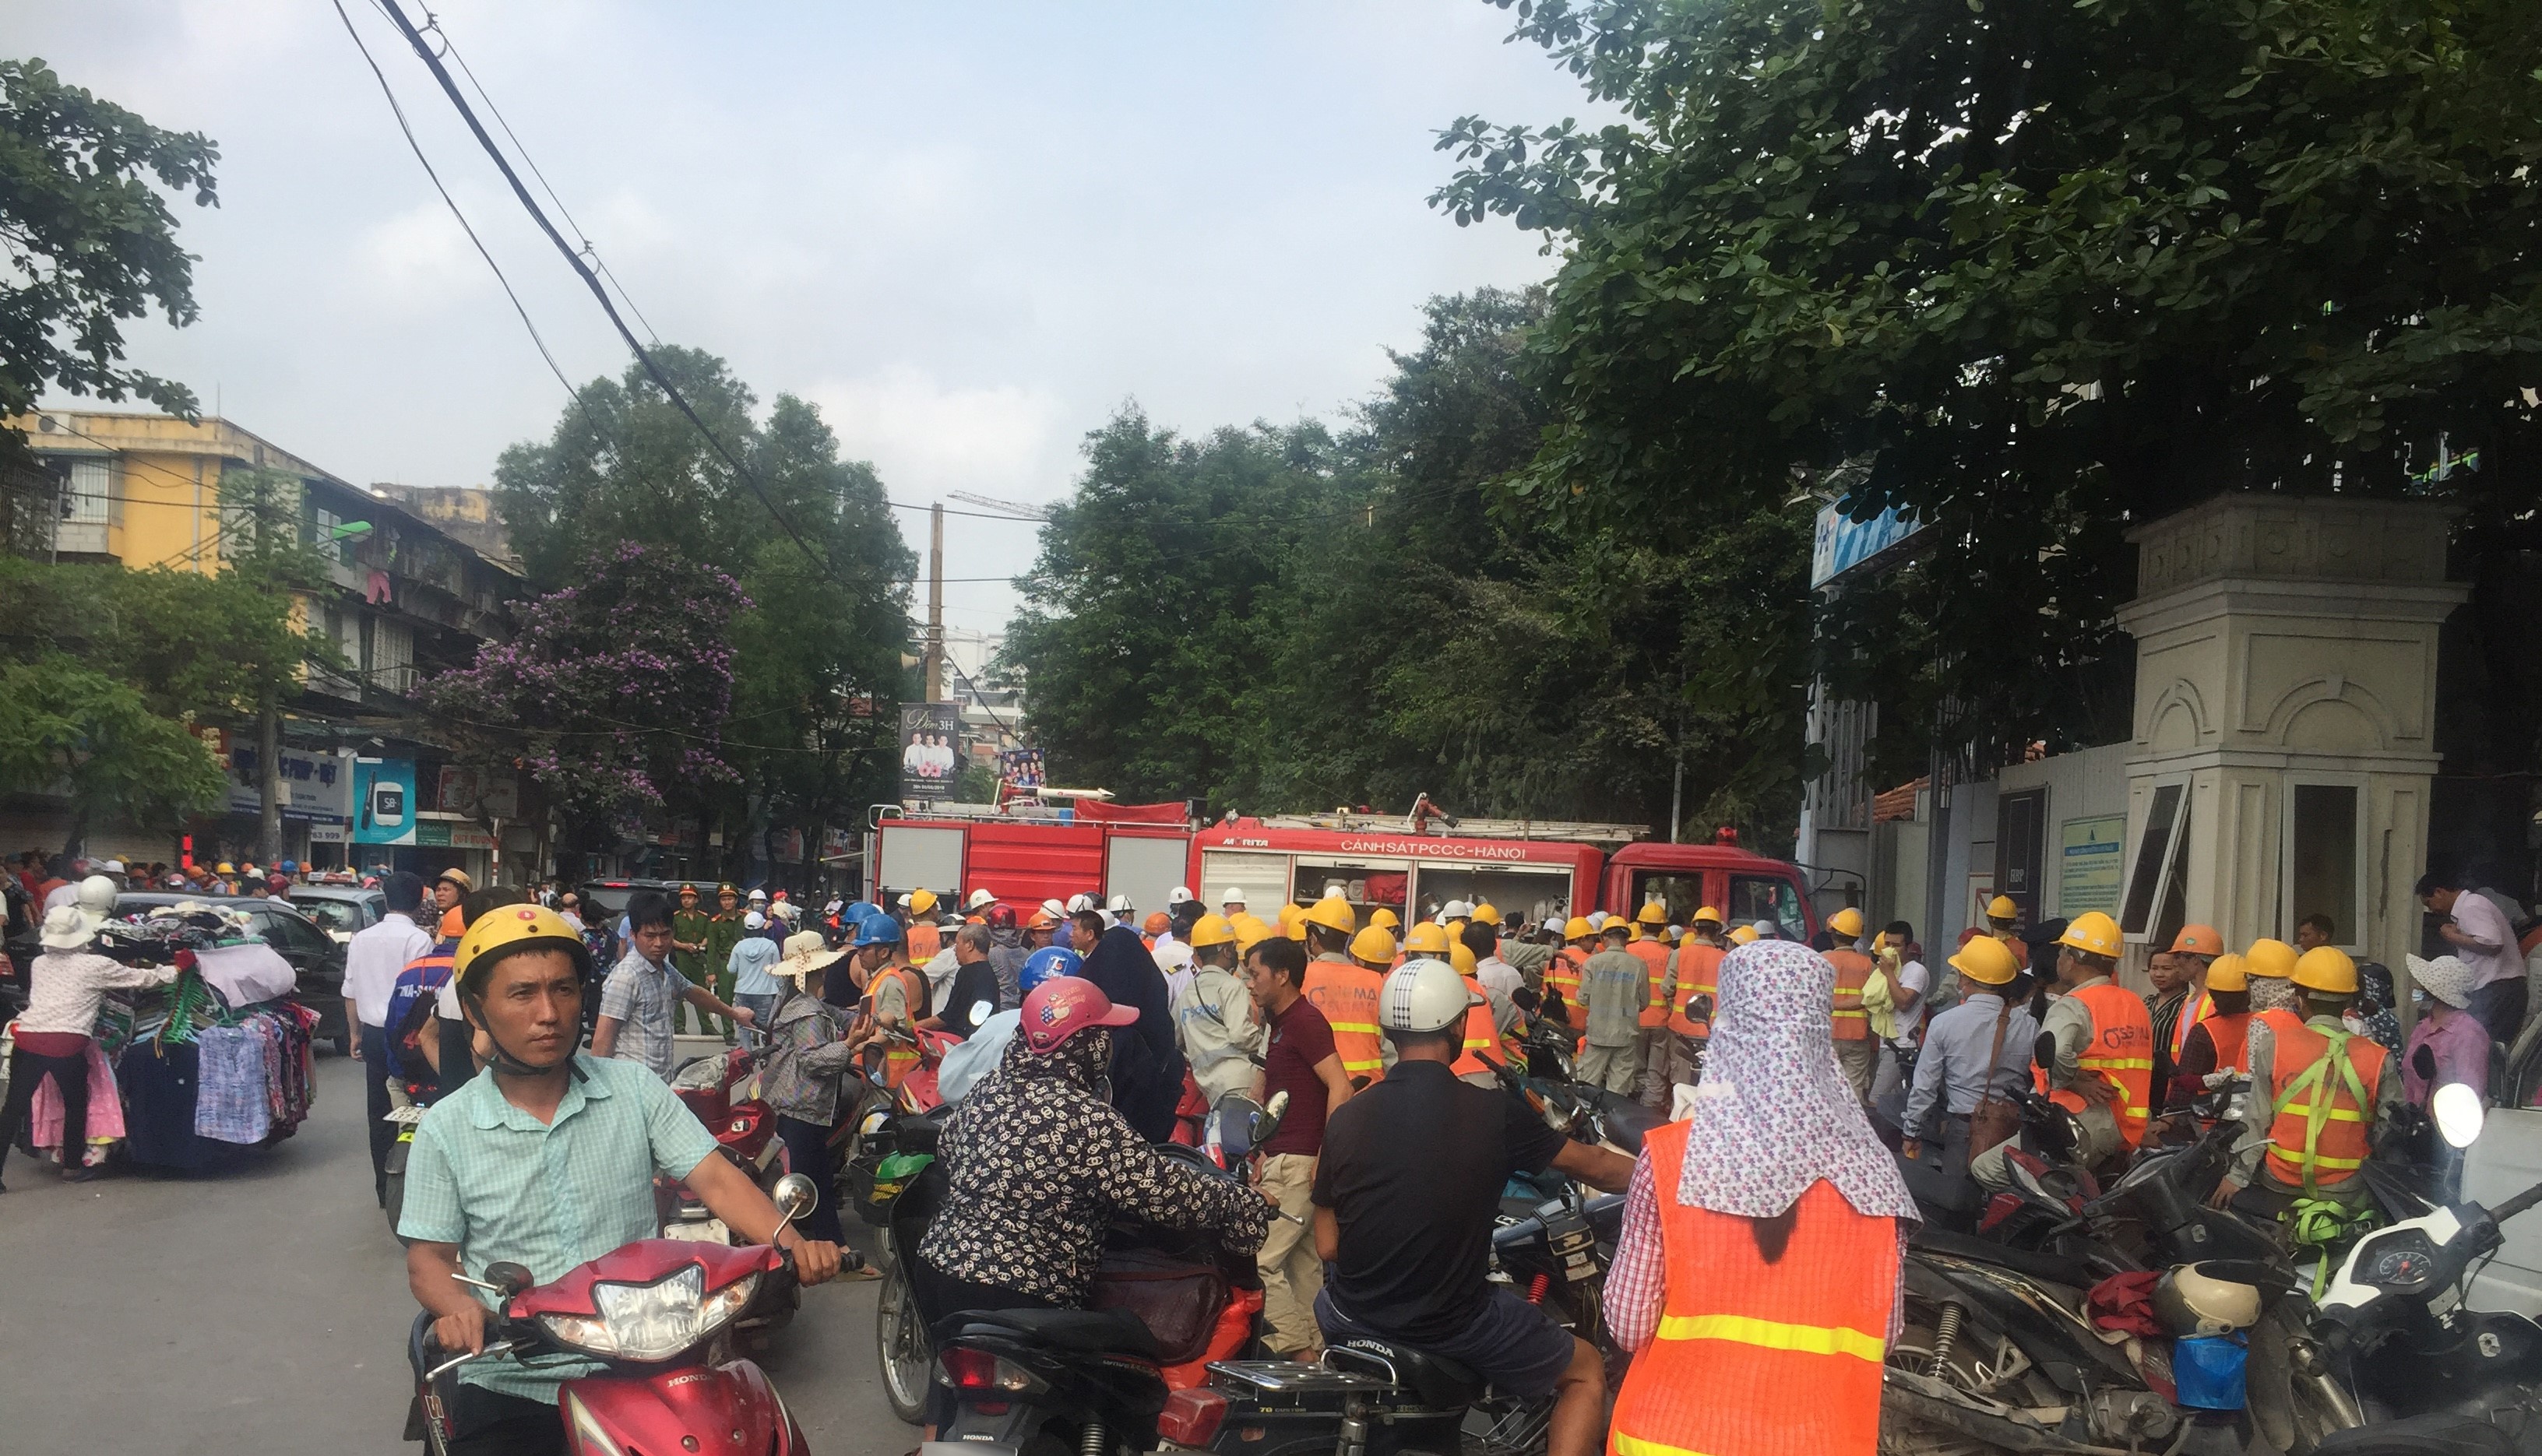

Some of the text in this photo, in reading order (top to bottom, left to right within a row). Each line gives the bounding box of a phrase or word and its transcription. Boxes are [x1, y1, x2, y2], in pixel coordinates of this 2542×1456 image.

[1223, 836, 1269, 847] MORITA
[1346, 1339, 1395, 1358] HONDA
[667, 1373, 714, 1387] HONDA
